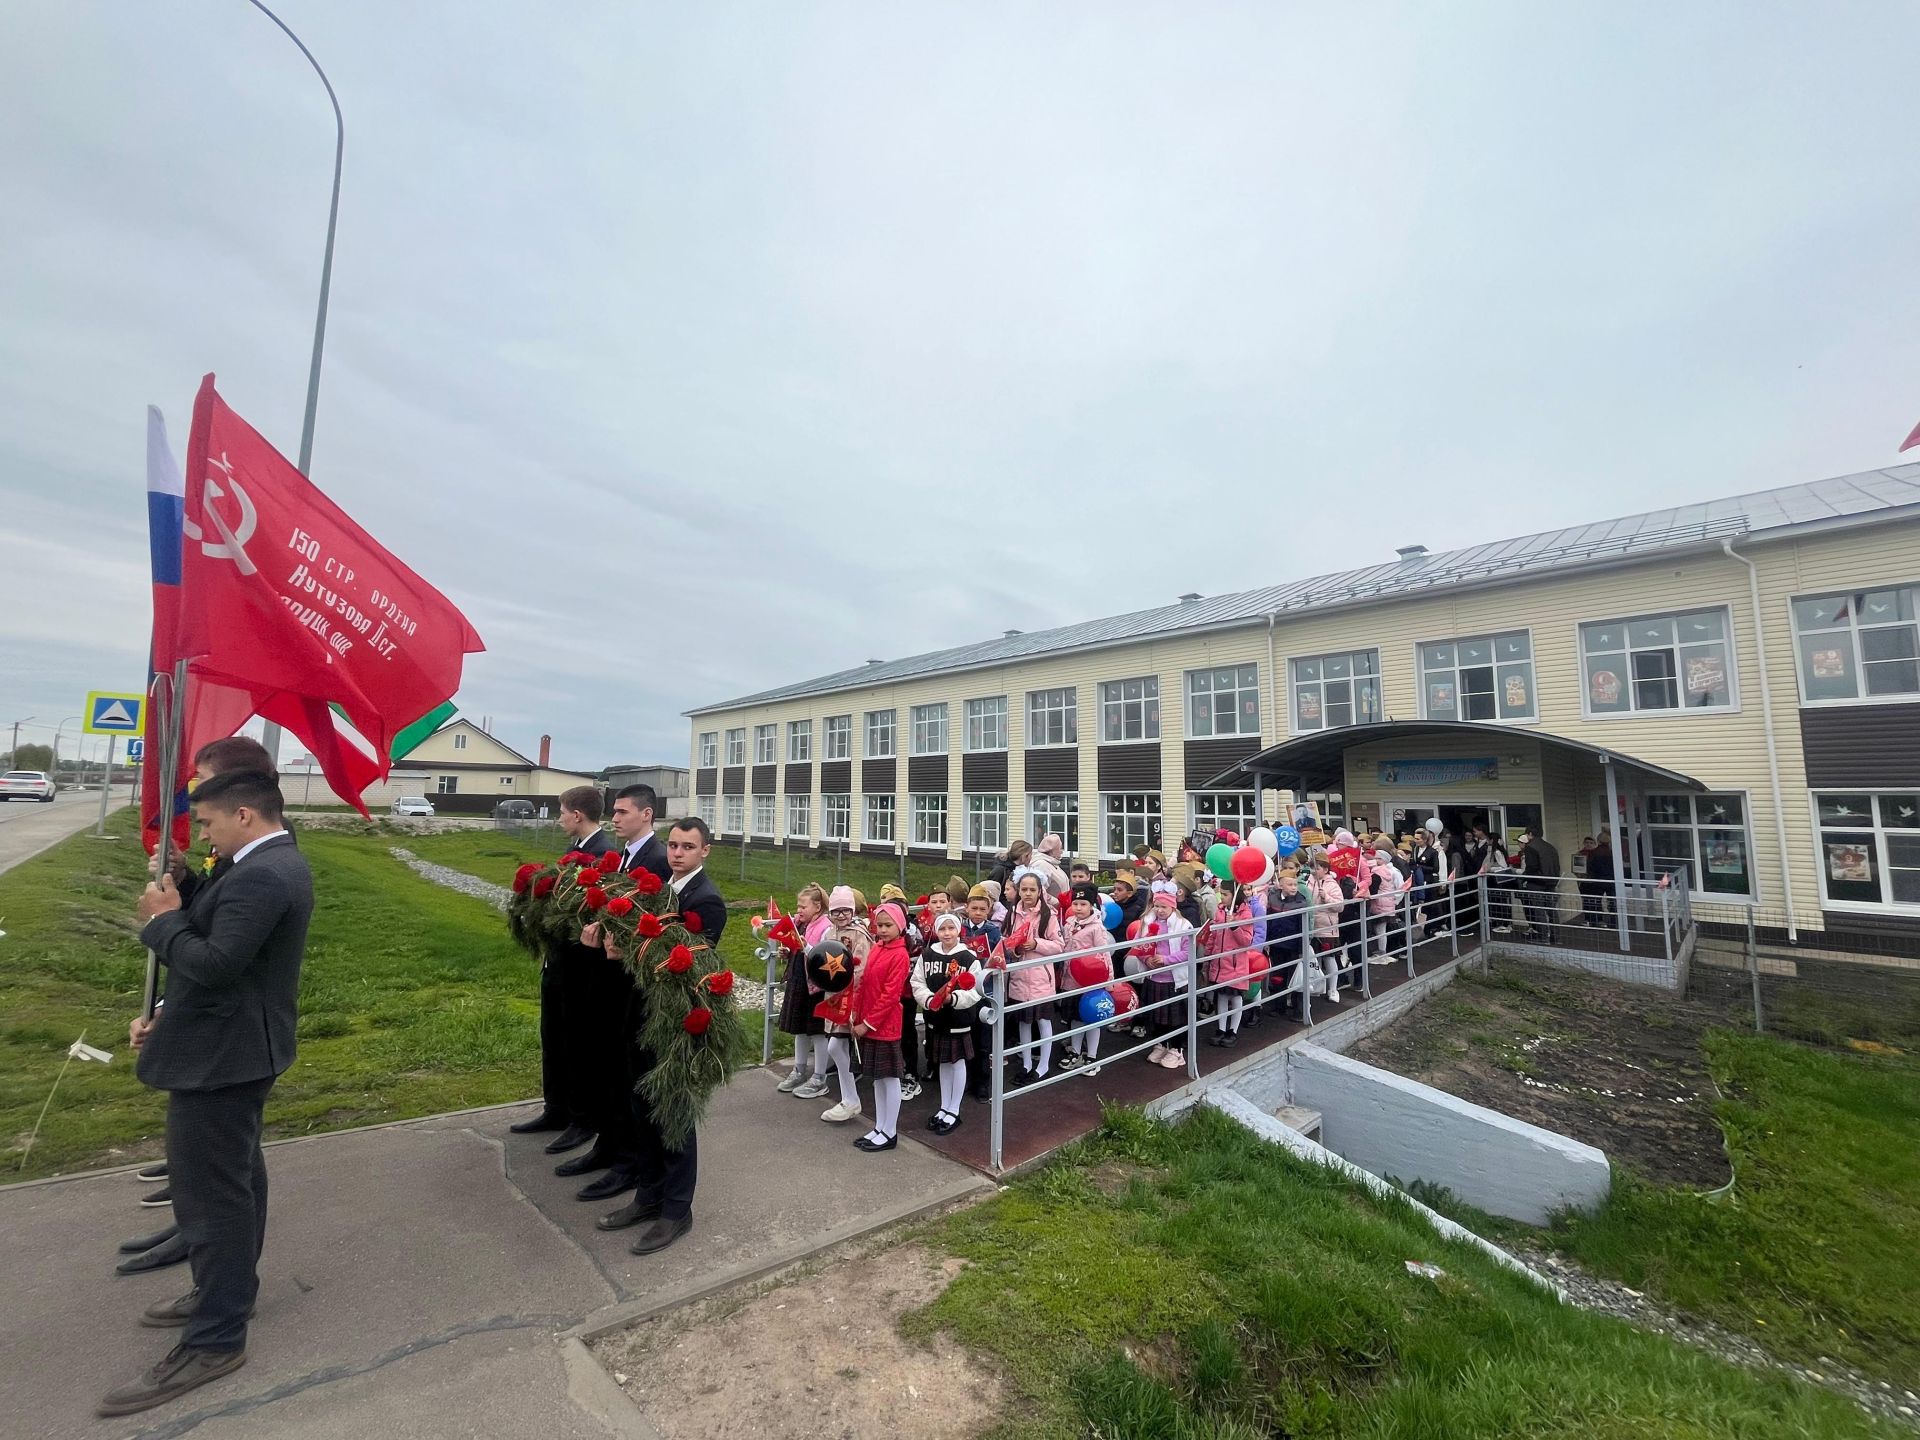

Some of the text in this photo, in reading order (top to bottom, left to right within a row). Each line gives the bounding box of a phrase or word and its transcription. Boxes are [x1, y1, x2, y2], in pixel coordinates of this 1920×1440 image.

[288, 527, 417, 637] 150 СТР. ОРДЕНА
[1153, 822, 1160, 833] 9
[1280, 830, 1289, 841] 9
